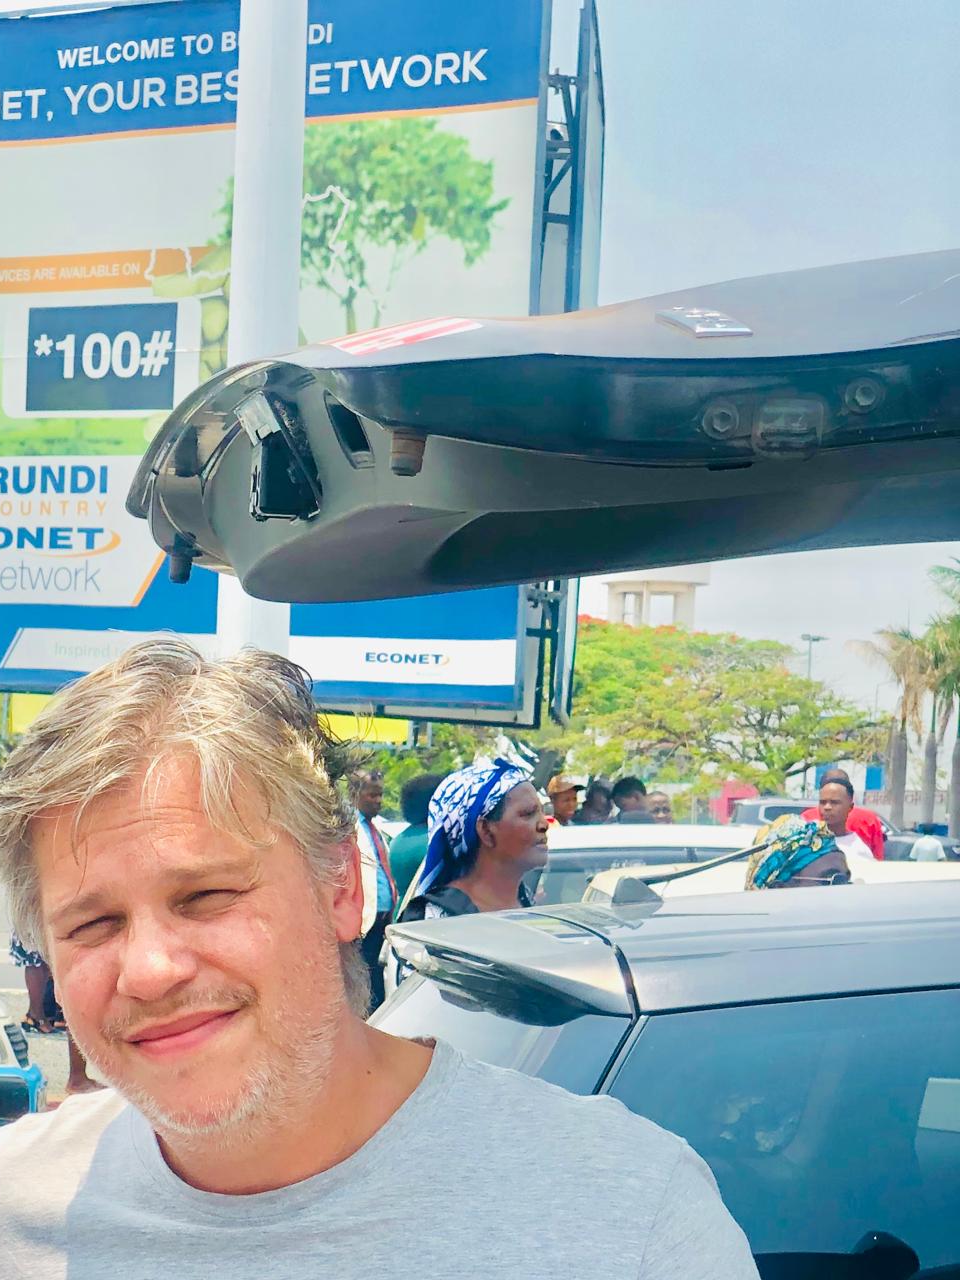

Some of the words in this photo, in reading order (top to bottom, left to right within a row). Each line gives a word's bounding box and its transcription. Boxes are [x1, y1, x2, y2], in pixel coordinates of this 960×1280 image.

[57, 37, 175, 69] WELCOME
[181, 34, 214, 56] TO
[64, 77, 167, 116] YOUR
[175, 69, 239, 106] BES
[308, 48, 488, 96] ETWORK
[33, 267, 57, 281] ARE
[59, 264, 119, 280] AVAILABLE
[124, 262, 140, 276] ON
[365, 652, 443, 665] ECONET
